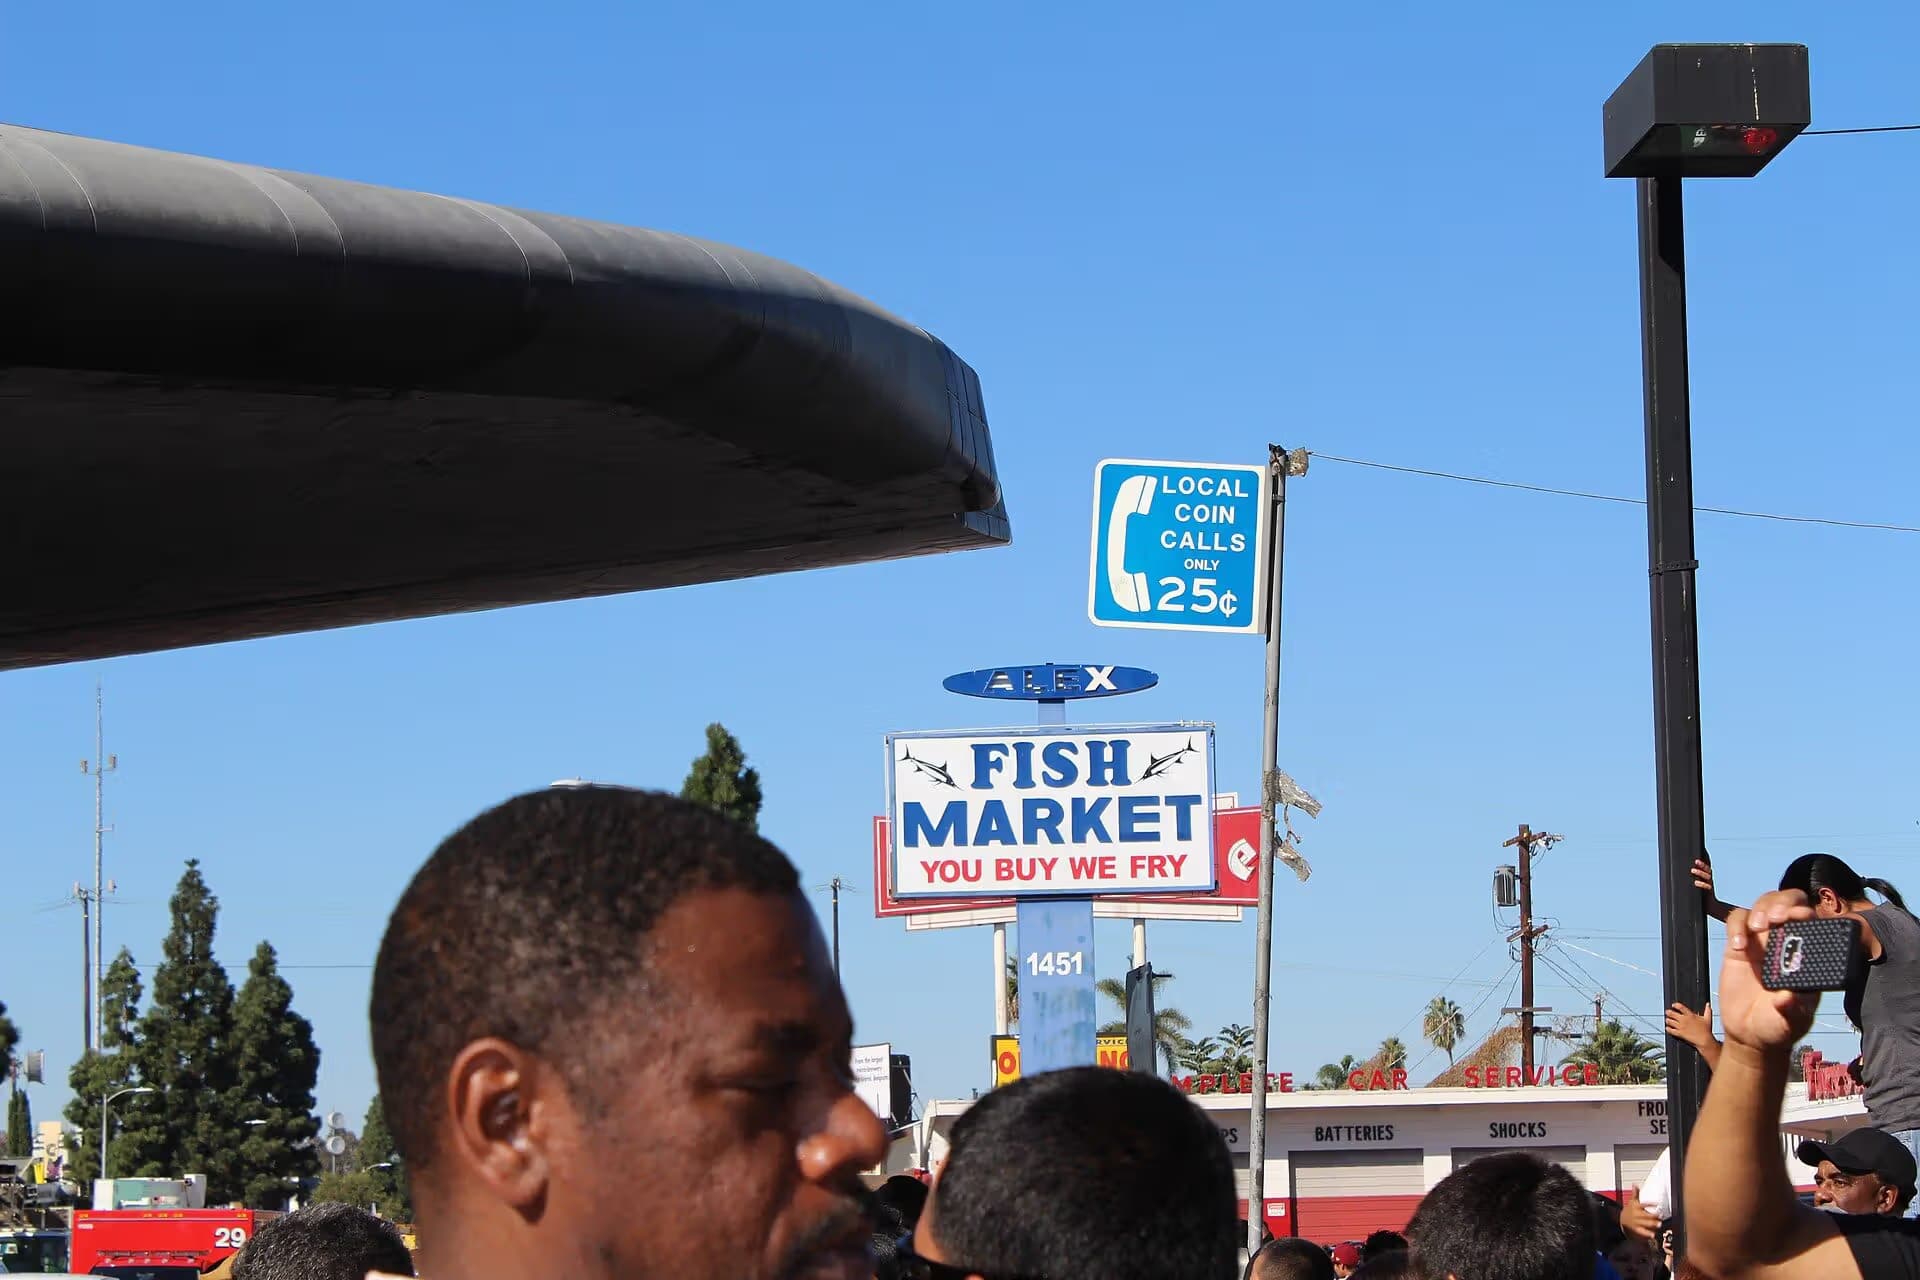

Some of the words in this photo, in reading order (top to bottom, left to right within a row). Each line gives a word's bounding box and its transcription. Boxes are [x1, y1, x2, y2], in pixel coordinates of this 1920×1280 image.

[1162, 475, 1249, 498] LOCAL
[1174, 503, 1235, 524] COIN
[1160, 530, 1246, 552] CALLS
[1184, 558, 1220, 571] ONLY
[982, 665, 1118, 694] ALEX
[970, 739, 1132, 790] FISH
[903, 794, 1202, 848] MARKET
[920, 859, 982, 884] YOU
[995, 857, 1059, 882] BUY
[1069, 856, 1117, 880] WE
[1130, 854, 1188, 879] FRY
[1026, 951, 1084, 977] 1451
[1171, 1072, 1293, 1094] MPLETE
[1349, 1069, 1408, 1091] CAR
[1464, 1064, 1599, 1088] SERVICE
[1638, 1101, 1667, 1116] FRO
[1314, 1124, 1394, 1143] BATTERIES
[1489, 1122, 1547, 1139] SHOCKS
[1650, 1119, 1667, 1134] SE
[215, 1227, 247, 1249] 29
